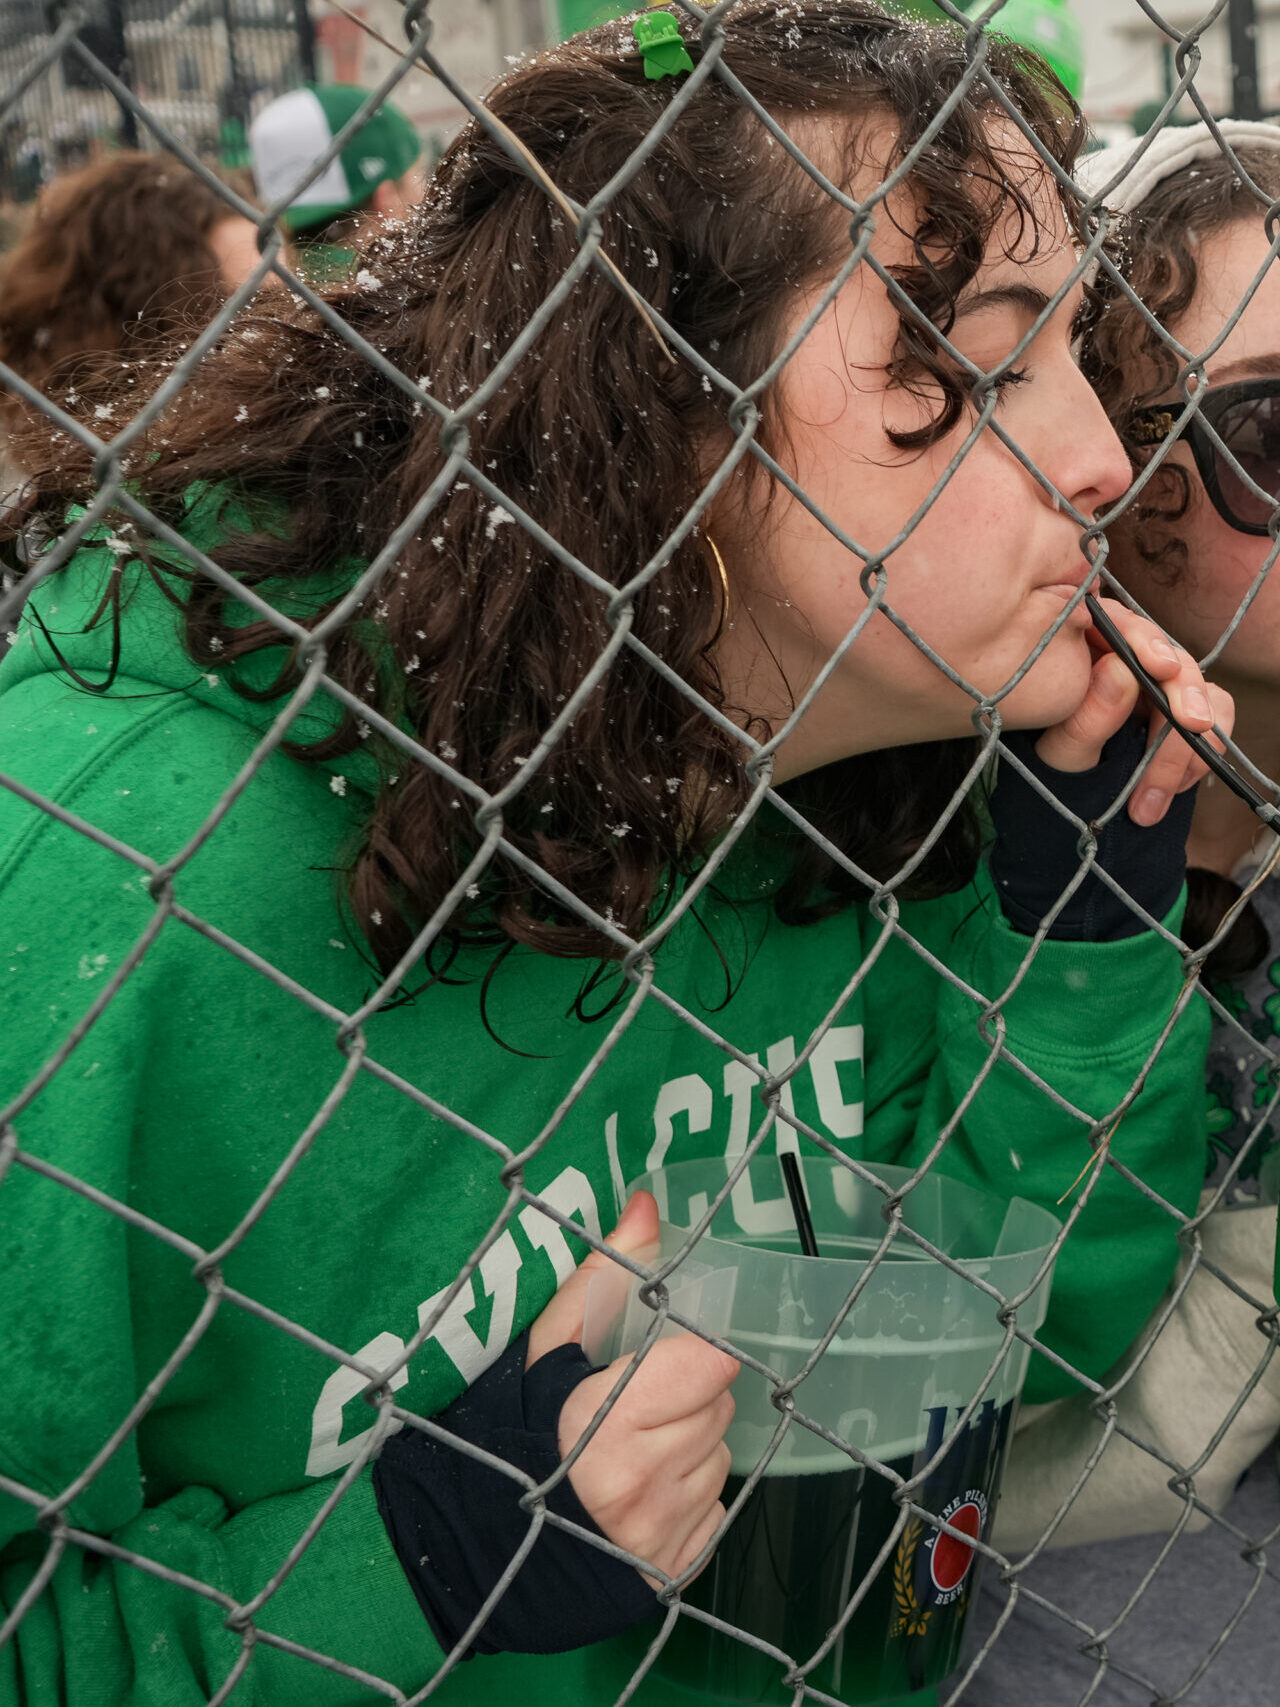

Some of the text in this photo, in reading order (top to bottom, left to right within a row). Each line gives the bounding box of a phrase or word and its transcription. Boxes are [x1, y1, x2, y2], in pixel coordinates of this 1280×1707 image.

[303, 1022, 865, 1477] SYRCUS
[923, 1537, 935, 1549] A
[934, 1584, 964, 1605] BEER
